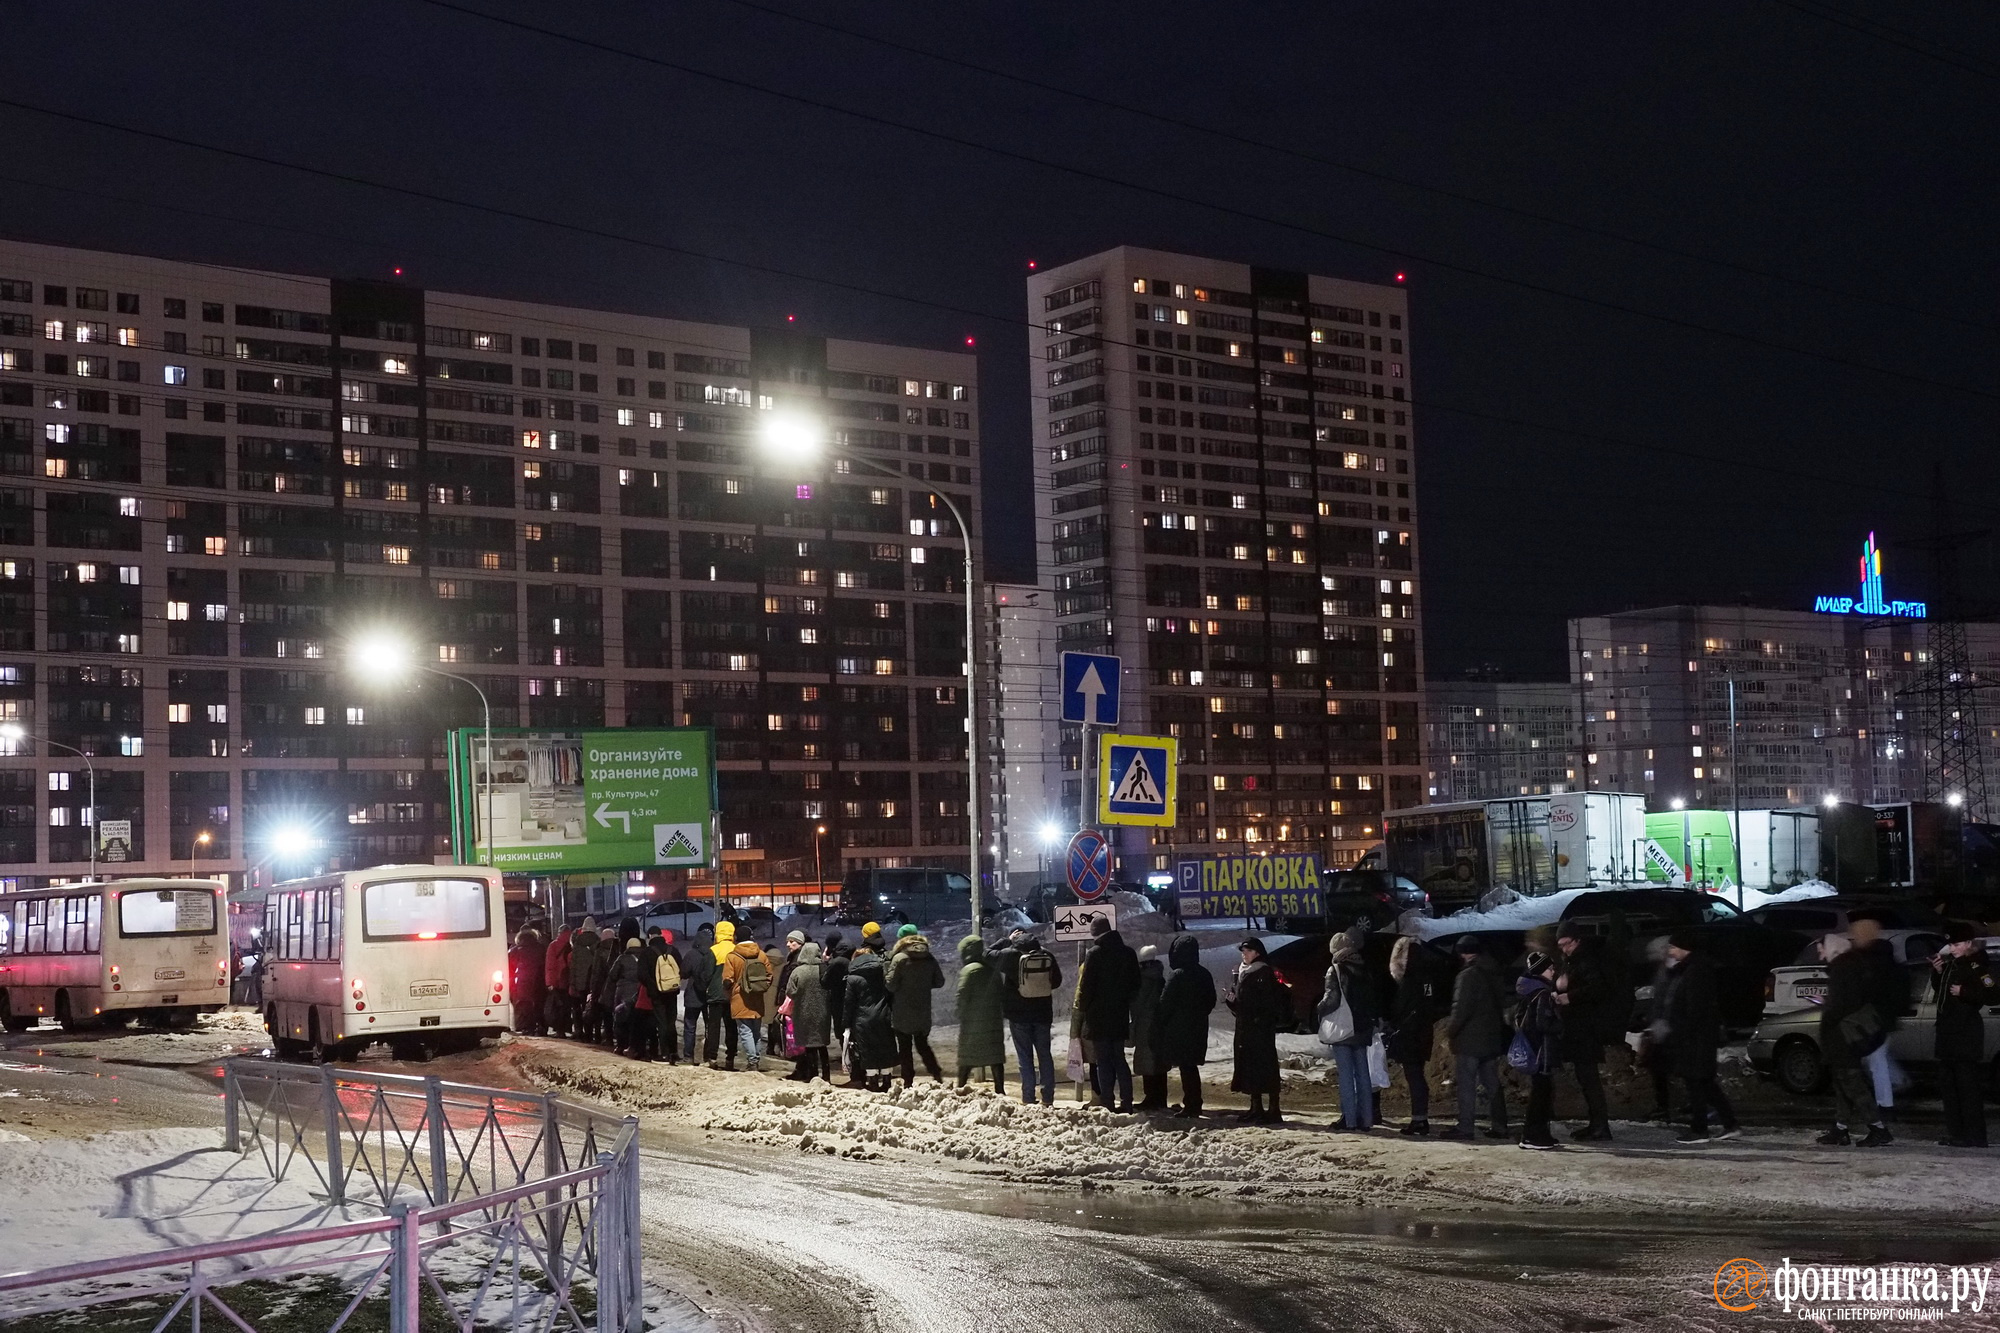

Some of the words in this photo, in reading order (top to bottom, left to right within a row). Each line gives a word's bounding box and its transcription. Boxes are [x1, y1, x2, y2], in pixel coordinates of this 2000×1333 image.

[1815, 596, 1853, 613] ЛИДЕР
[1892, 601, 1926, 618] ГРУПП
[589, 747, 682, 764] Организуйте
[590, 769, 660, 782] хранение
[662, 767, 699, 780] дома
[591, 791, 604, 799] пр.
[605, 790, 649, 799] Культуры,
[649, 789, 659, 797] 47
[631, 808, 644, 818] 4,3
[1551, 812, 1574, 824] ENTIS
[659, 835, 678, 857] LEROY
[674, 830, 699, 856] MERLIN
[494, 853, 531, 862] НИЗКИМ
[532, 851, 563, 861] ЦЕНАМ
[1647, 845, 1677, 879] MERLIN
[1202, 856, 1319, 892] ПАРКОВКА
[1204, 895, 1219, 916] +7
[1223, 895, 1247, 916] 921
[1252, 894, 1278, 916] 556
[1281, 893, 1299, 915] 56
[1302, 893, 1319, 915] 11
